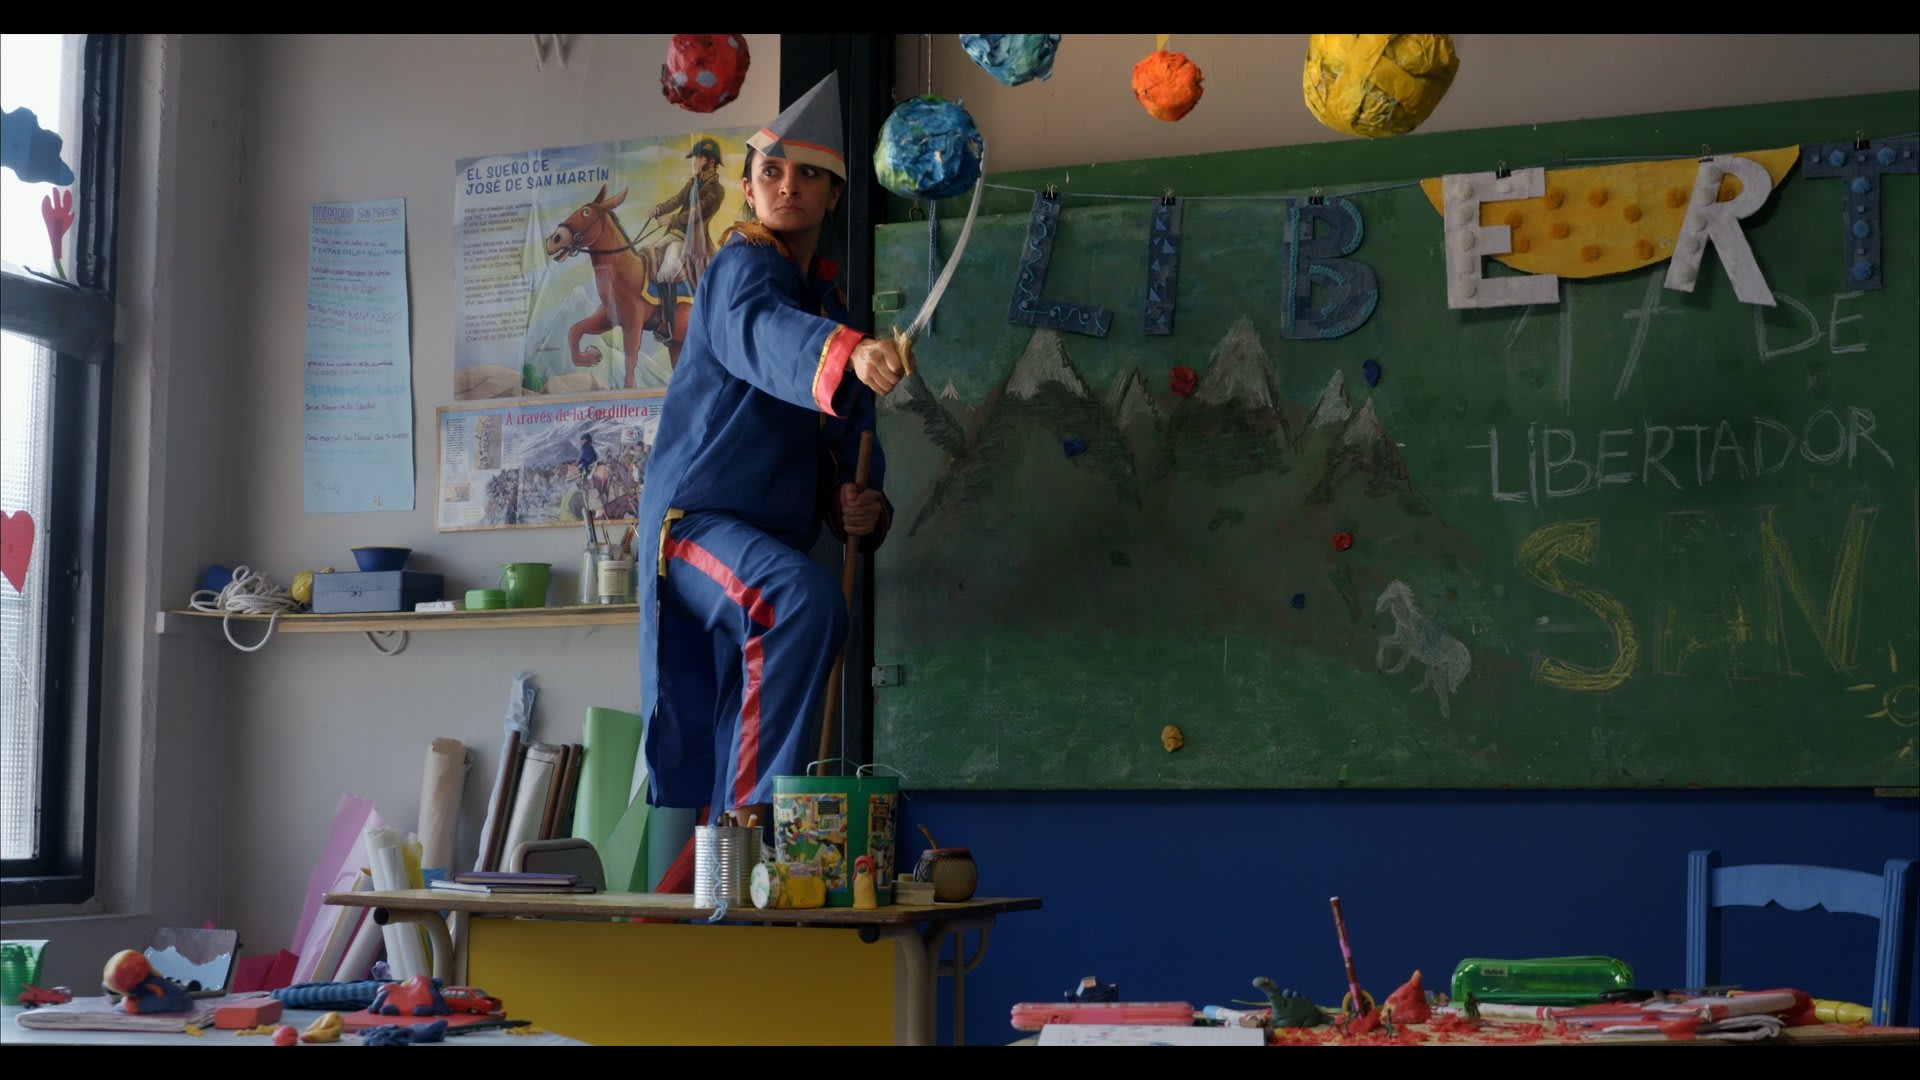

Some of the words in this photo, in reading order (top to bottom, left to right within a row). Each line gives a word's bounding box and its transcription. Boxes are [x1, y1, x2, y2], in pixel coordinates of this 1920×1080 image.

[465, 180, 501, 196] JOSÉ
[505, 178, 523, 192] DE
[527, 174, 552, 190] SAN
[556, 166, 610, 185] MARTÍN
[466, 168, 482, 181] EL
[486, 161, 530, 179] SUEÑO
[533, 159, 550, 173] DE
[1753, 288, 1869, 363] DE
[505, 413, 513, 426] A
[517, 410, 553, 425] través
[555, 408, 570, 422] de
[573, 406, 585, 421] la
[587, 404, 649, 421] Cordillera
[1489, 405, 1896, 508] LIBERTADOR
